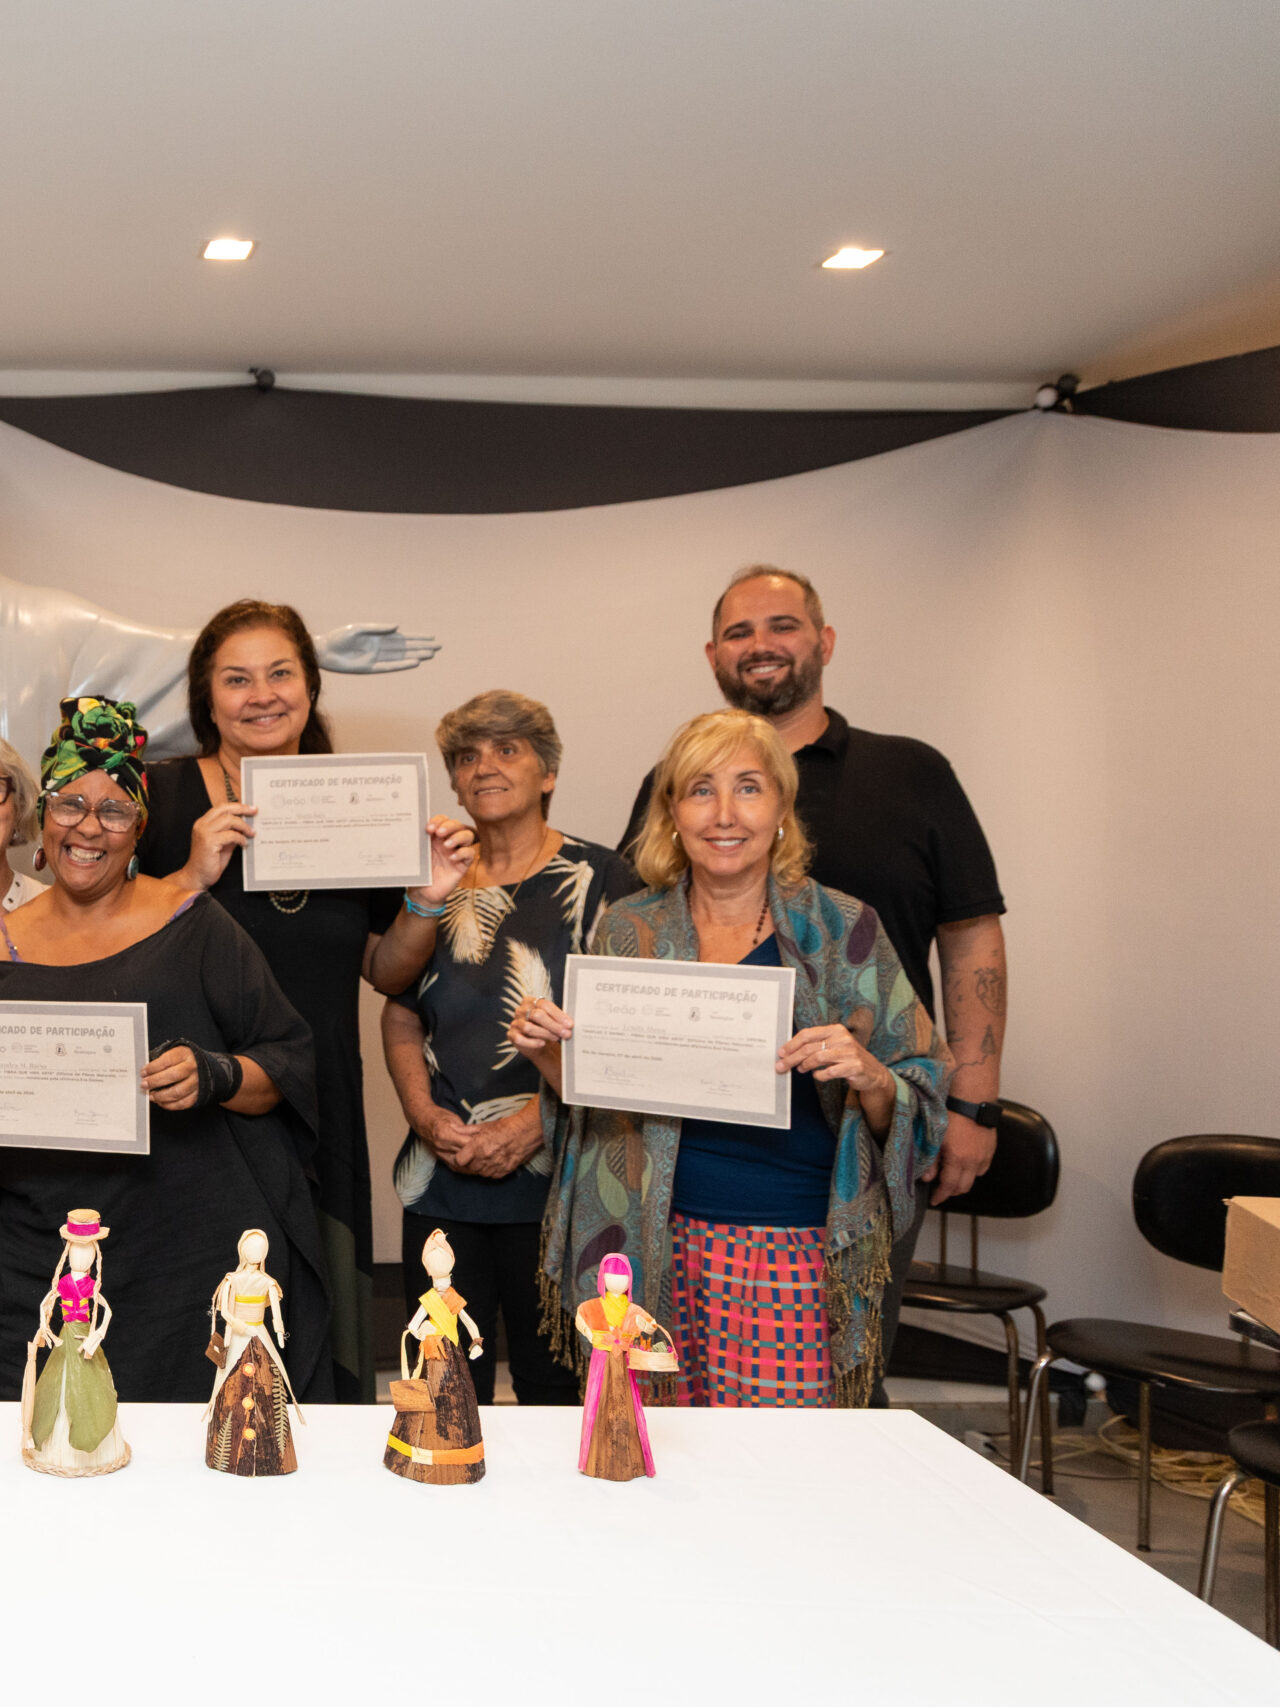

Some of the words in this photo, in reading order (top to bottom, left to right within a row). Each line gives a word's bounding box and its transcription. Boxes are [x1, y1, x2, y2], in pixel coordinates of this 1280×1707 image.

[270, 778, 325, 788] CERTIFICADO
[327, 777, 339, 786] DE
[342, 774, 402, 786] PARTICIPAÇÃO
[595, 982, 661, 995] CERTIFICADO
[664, 986, 678, 997] DE
[681, 988, 758, 1004] PARTICIPAÇÃO
[30, 1026, 42, 1035] DE
[46, 1025, 116, 1039] PARTICIPAÇÃO
